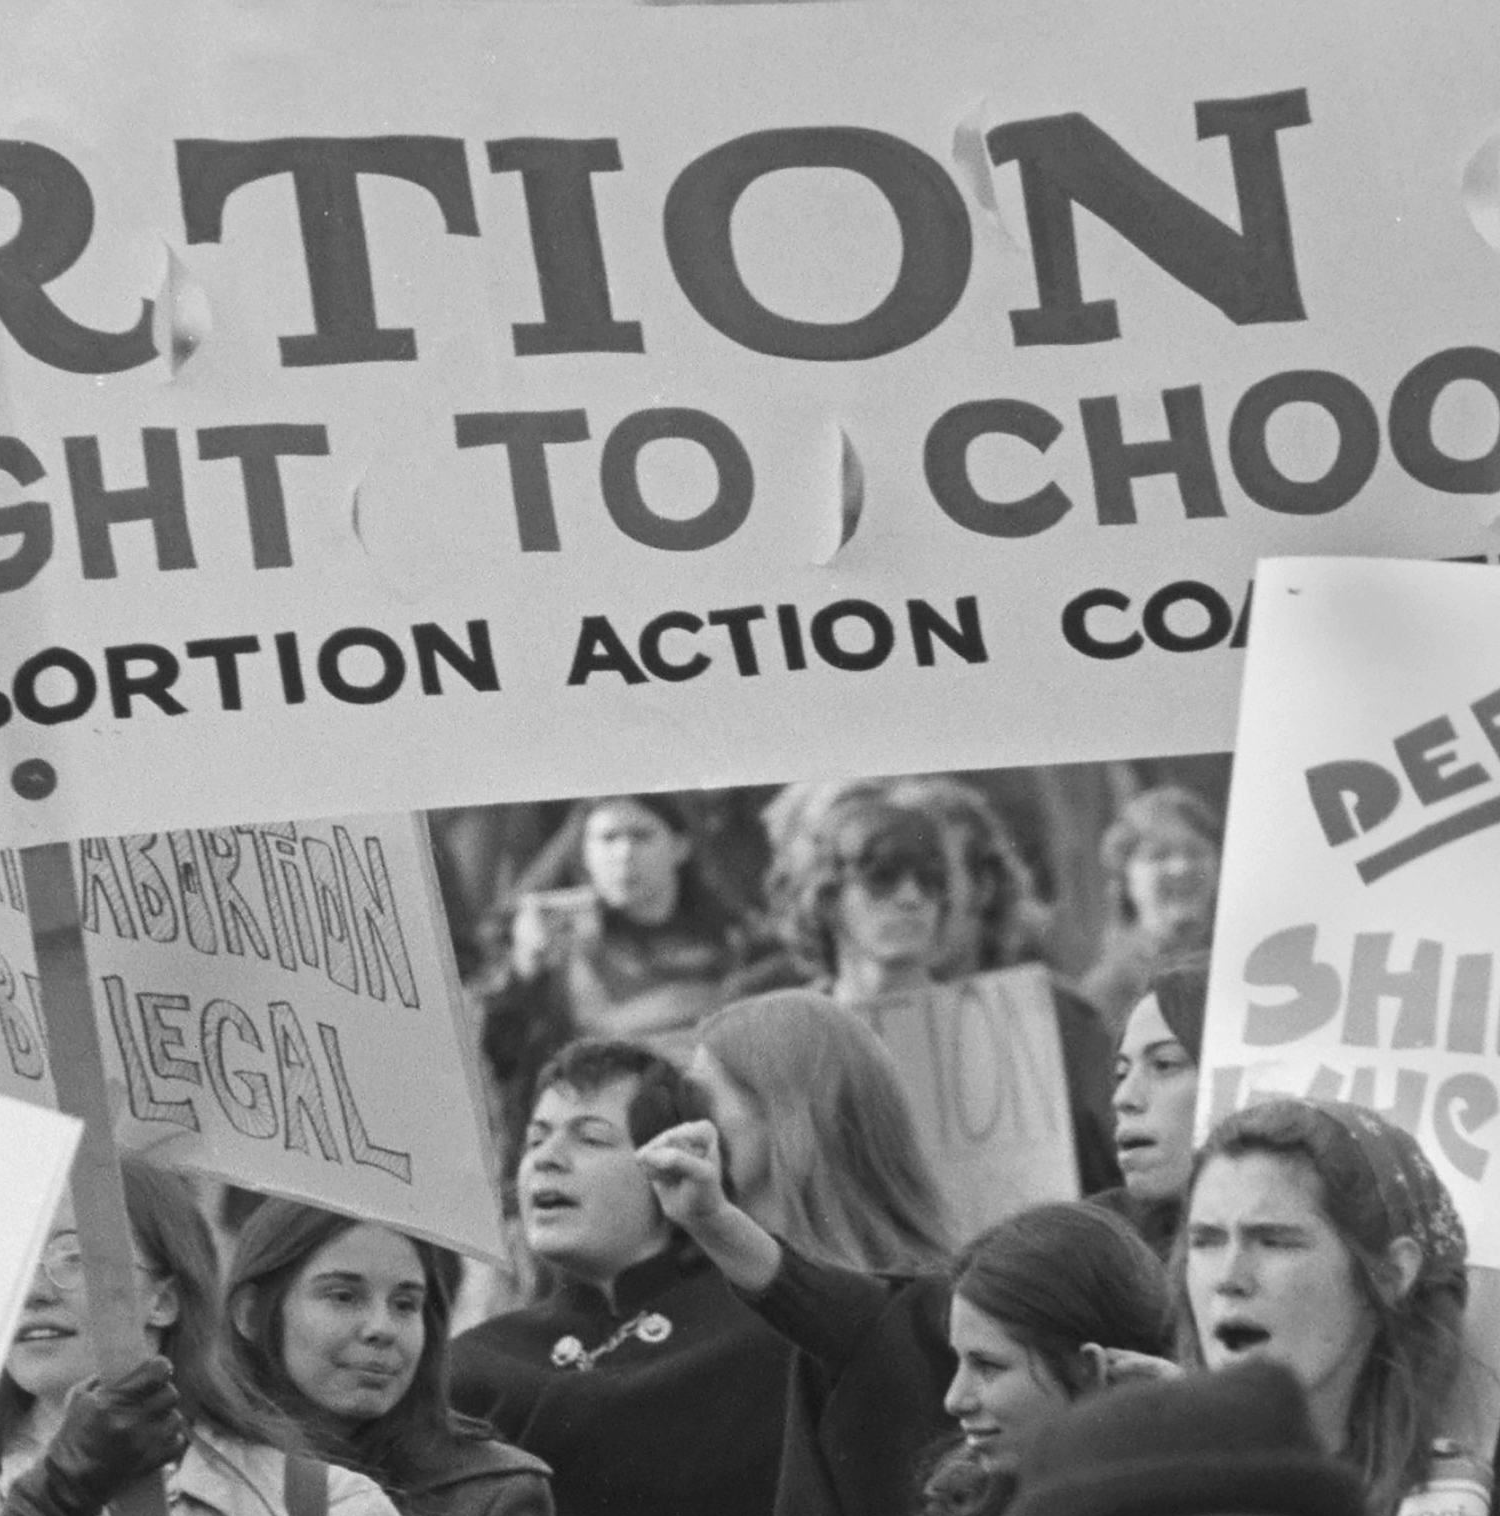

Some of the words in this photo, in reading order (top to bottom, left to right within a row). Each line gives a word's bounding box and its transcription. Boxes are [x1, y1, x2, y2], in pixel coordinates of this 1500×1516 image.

[454, 405, 755, 553] TO
[566, 595, 990, 686] ACTION
[82, 821, 419, 1009] ABORTION
[102, 974, 412, 1187] LEGAL
